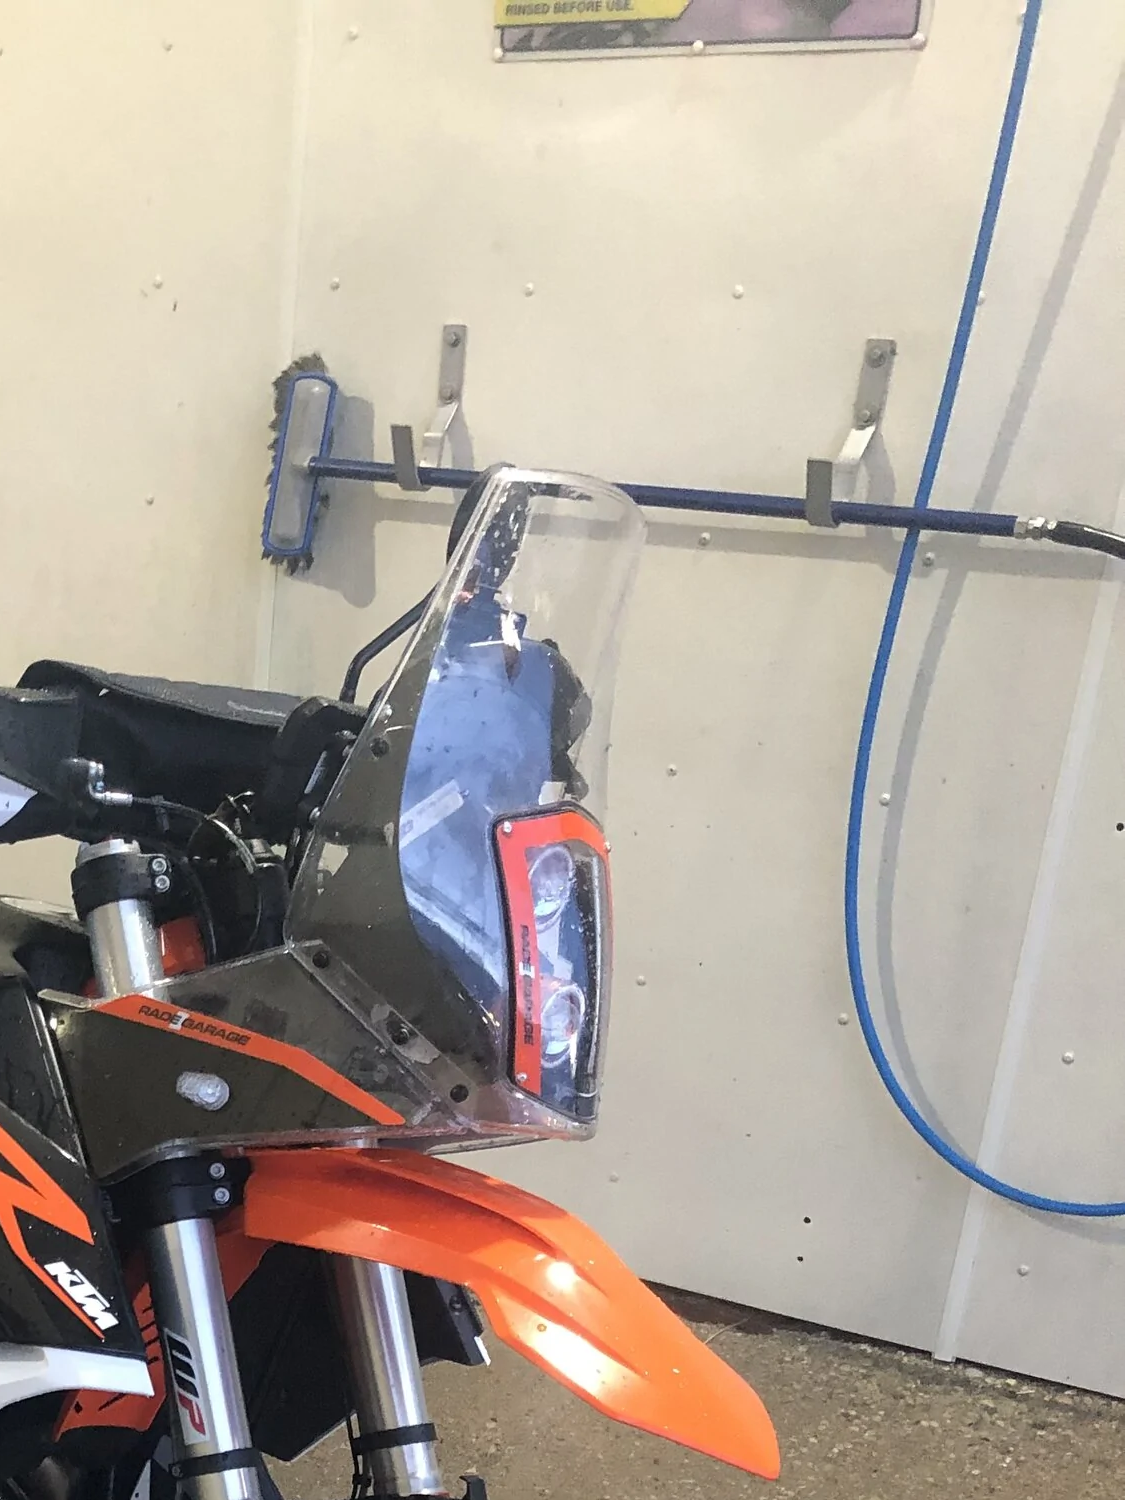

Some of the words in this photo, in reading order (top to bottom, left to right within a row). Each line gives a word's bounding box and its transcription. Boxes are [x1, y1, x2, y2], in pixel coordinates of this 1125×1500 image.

[506, 3, 550, 15] RINSED
[553, 0, 602, 13] BEFORE
[139, 1005, 182, 1025] RADE
[182, 1018, 251, 1045] GARAGE
[44, 1261, 119, 1331] KTM
[167, 1334, 206, 1436] WP
